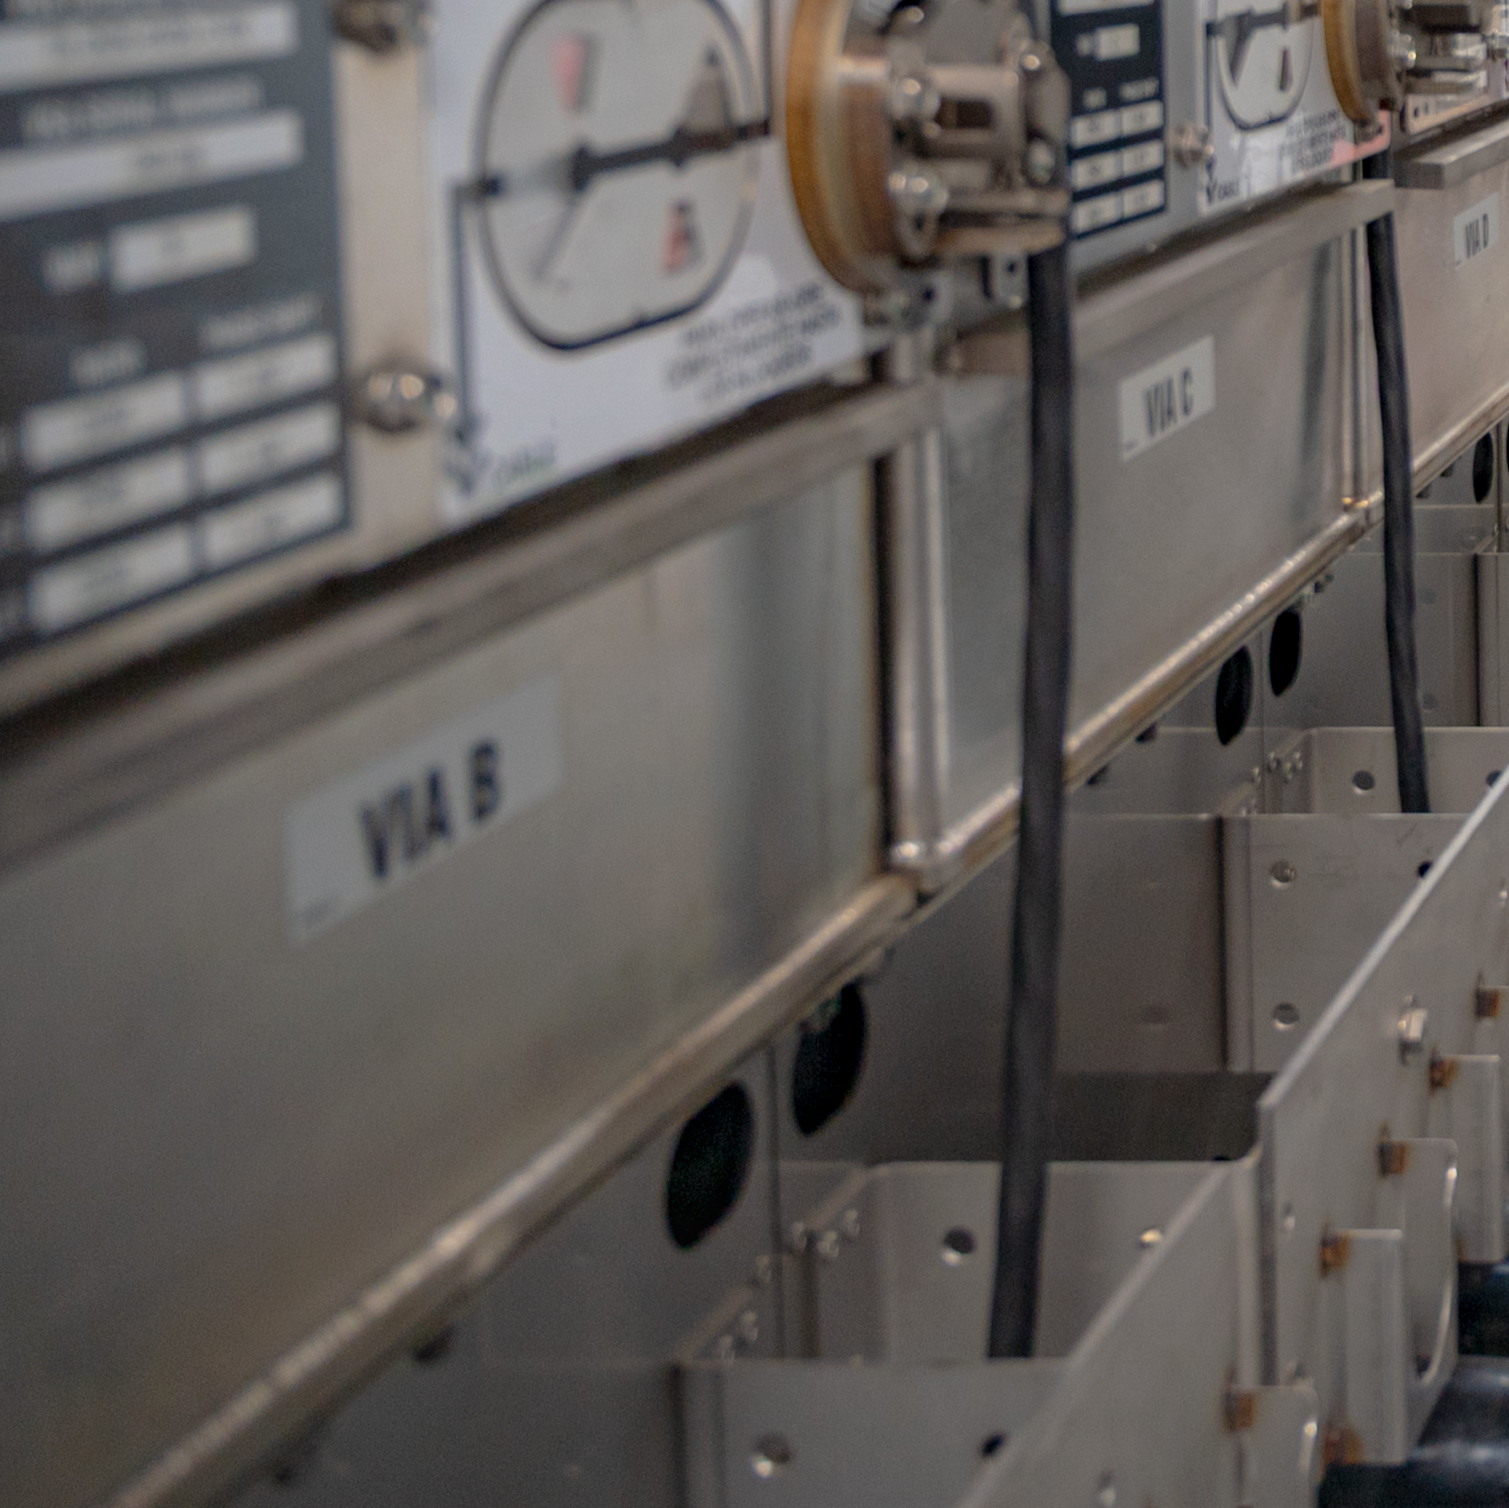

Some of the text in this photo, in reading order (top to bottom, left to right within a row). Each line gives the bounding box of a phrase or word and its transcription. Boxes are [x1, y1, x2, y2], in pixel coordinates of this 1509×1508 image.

[1465, 213, 1489, 260] VIA D
[1143, 367, 1193, 437] VIA C
[360, 735, 503, 880] VIA B
